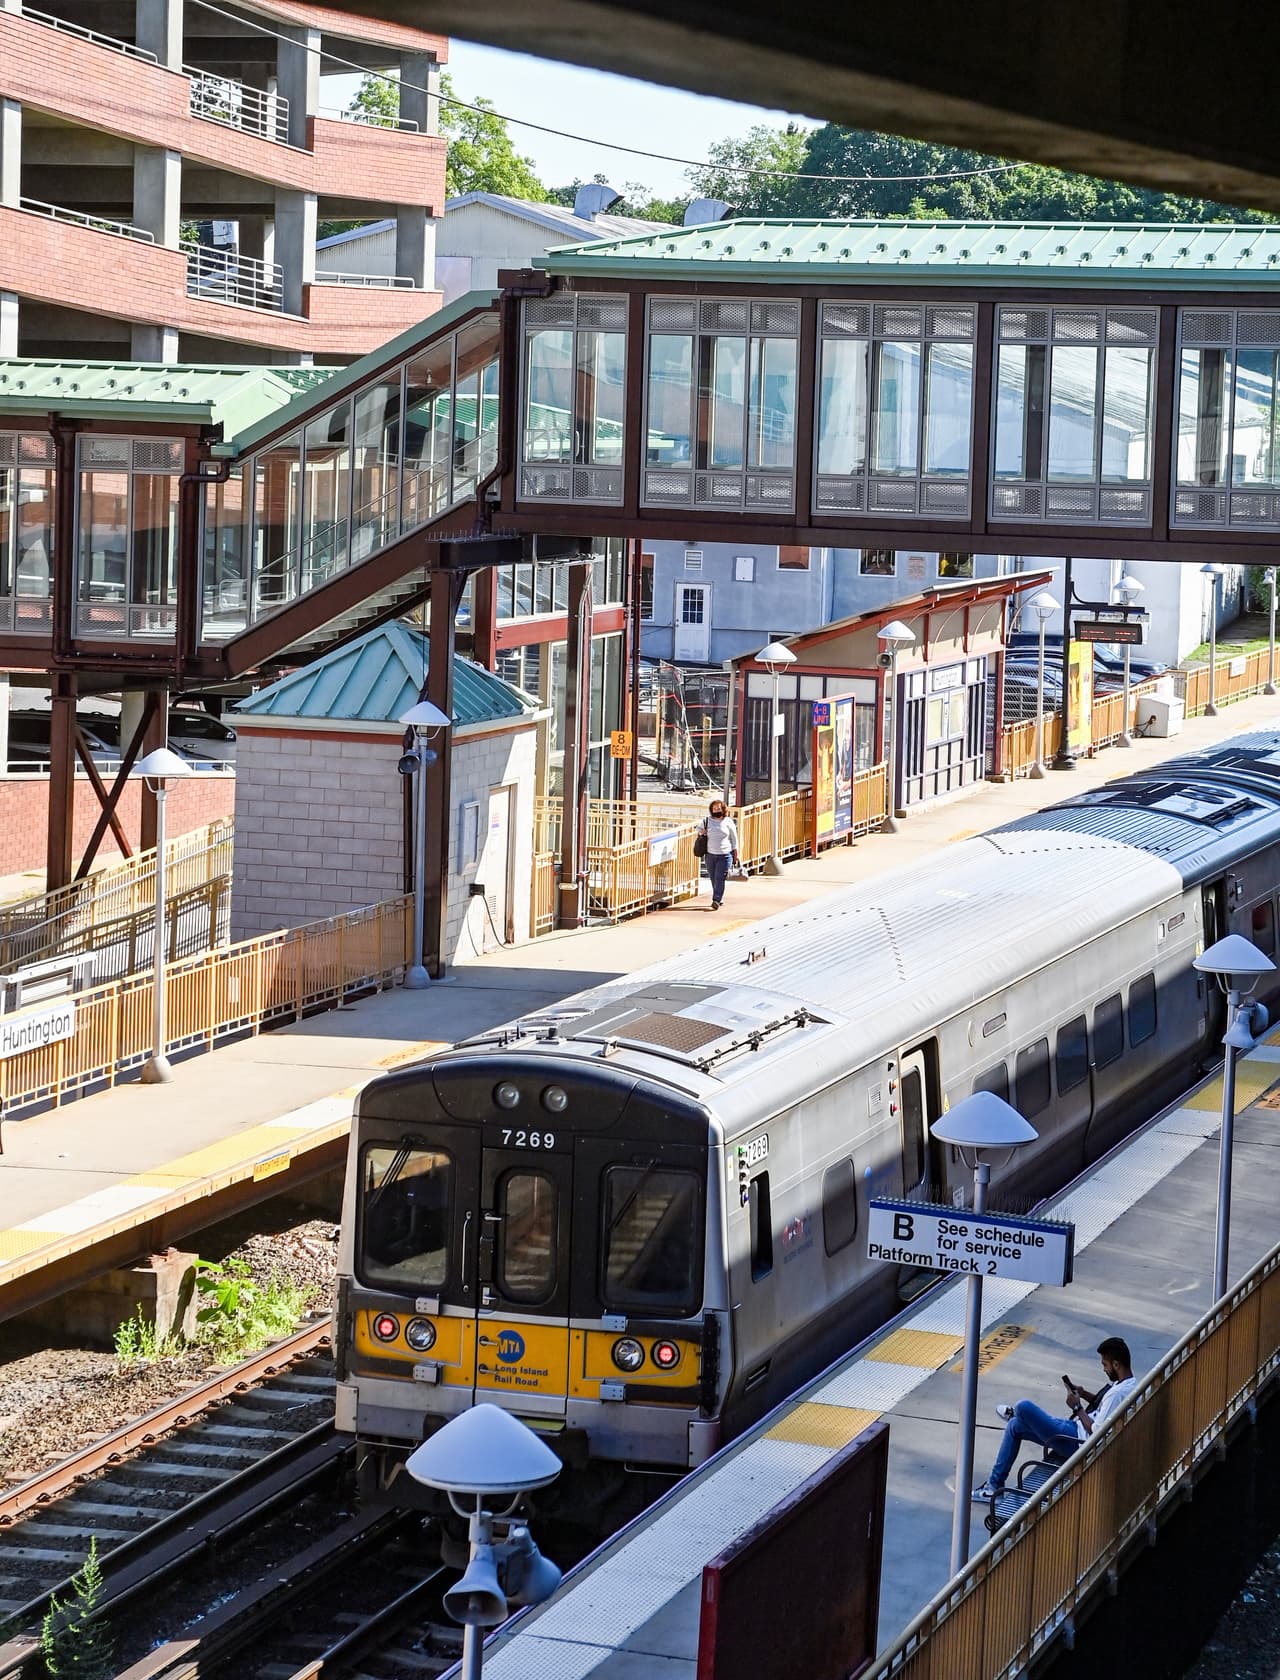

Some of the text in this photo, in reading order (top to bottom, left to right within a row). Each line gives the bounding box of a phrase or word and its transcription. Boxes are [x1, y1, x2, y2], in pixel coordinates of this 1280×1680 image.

[617, 733, 625, 745] 8
[3, 1014, 70, 1052] Huntington
[502, 1129, 555, 1149] 7269
[748, 1136, 767, 1162] 7269
[893, 1213, 1045, 1248] B See schedule
[937, 1234, 1022, 1260] for service
[869, 1243, 997, 1275] Platform Track 2
[497, 1338, 520, 1355] MTA
[984, 1338, 1014, 1351] THE
[495, 1364, 548, 1377] Long Island
[494, 1375, 538, 1387] Rail Road
